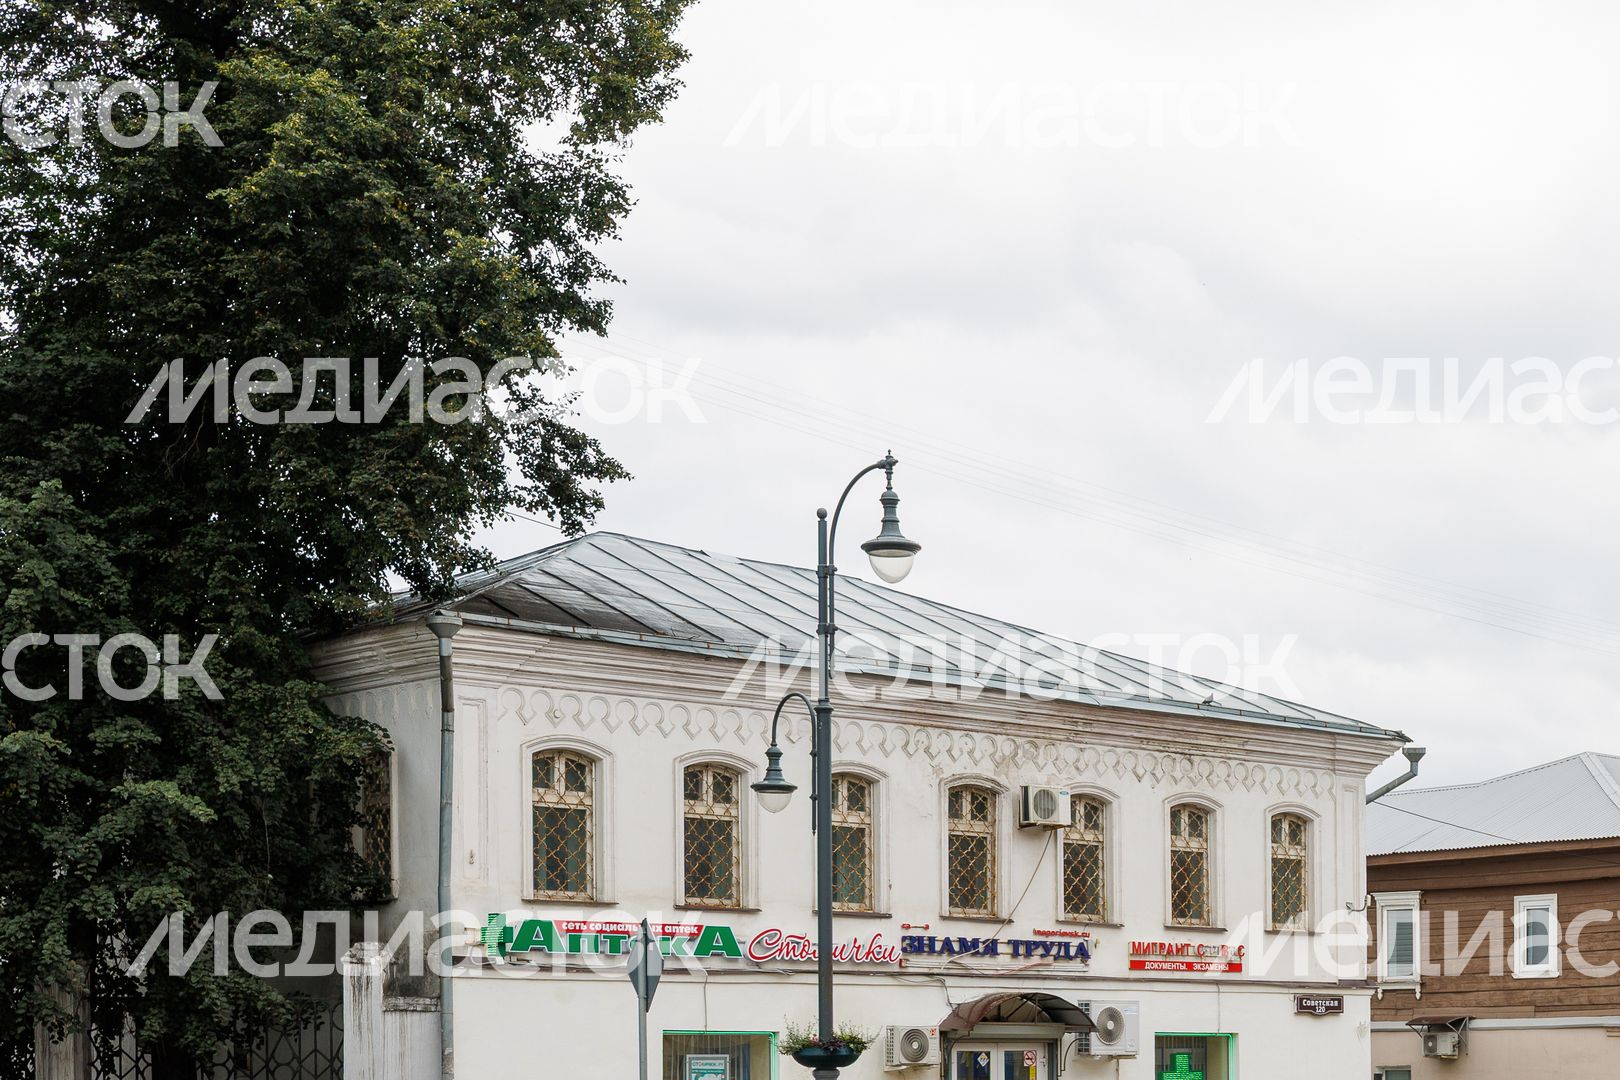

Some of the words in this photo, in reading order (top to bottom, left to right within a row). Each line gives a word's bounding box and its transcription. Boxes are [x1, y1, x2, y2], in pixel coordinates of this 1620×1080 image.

[562, 921, 587, 931] сеть
[665, 924, 699, 935] аптек
[748, 927, 901, 963] Стоички
[901, 935, 1001, 957] ЗНАМЯ
[1007, 939, 1092, 961] ТРУДА
[1131, 941, 1192, 957] МИГРАНТ
[1192, 963, 1230, 971] ЭКЗАМЕНЫ
[1302, 999, 1340, 1007] Советская
